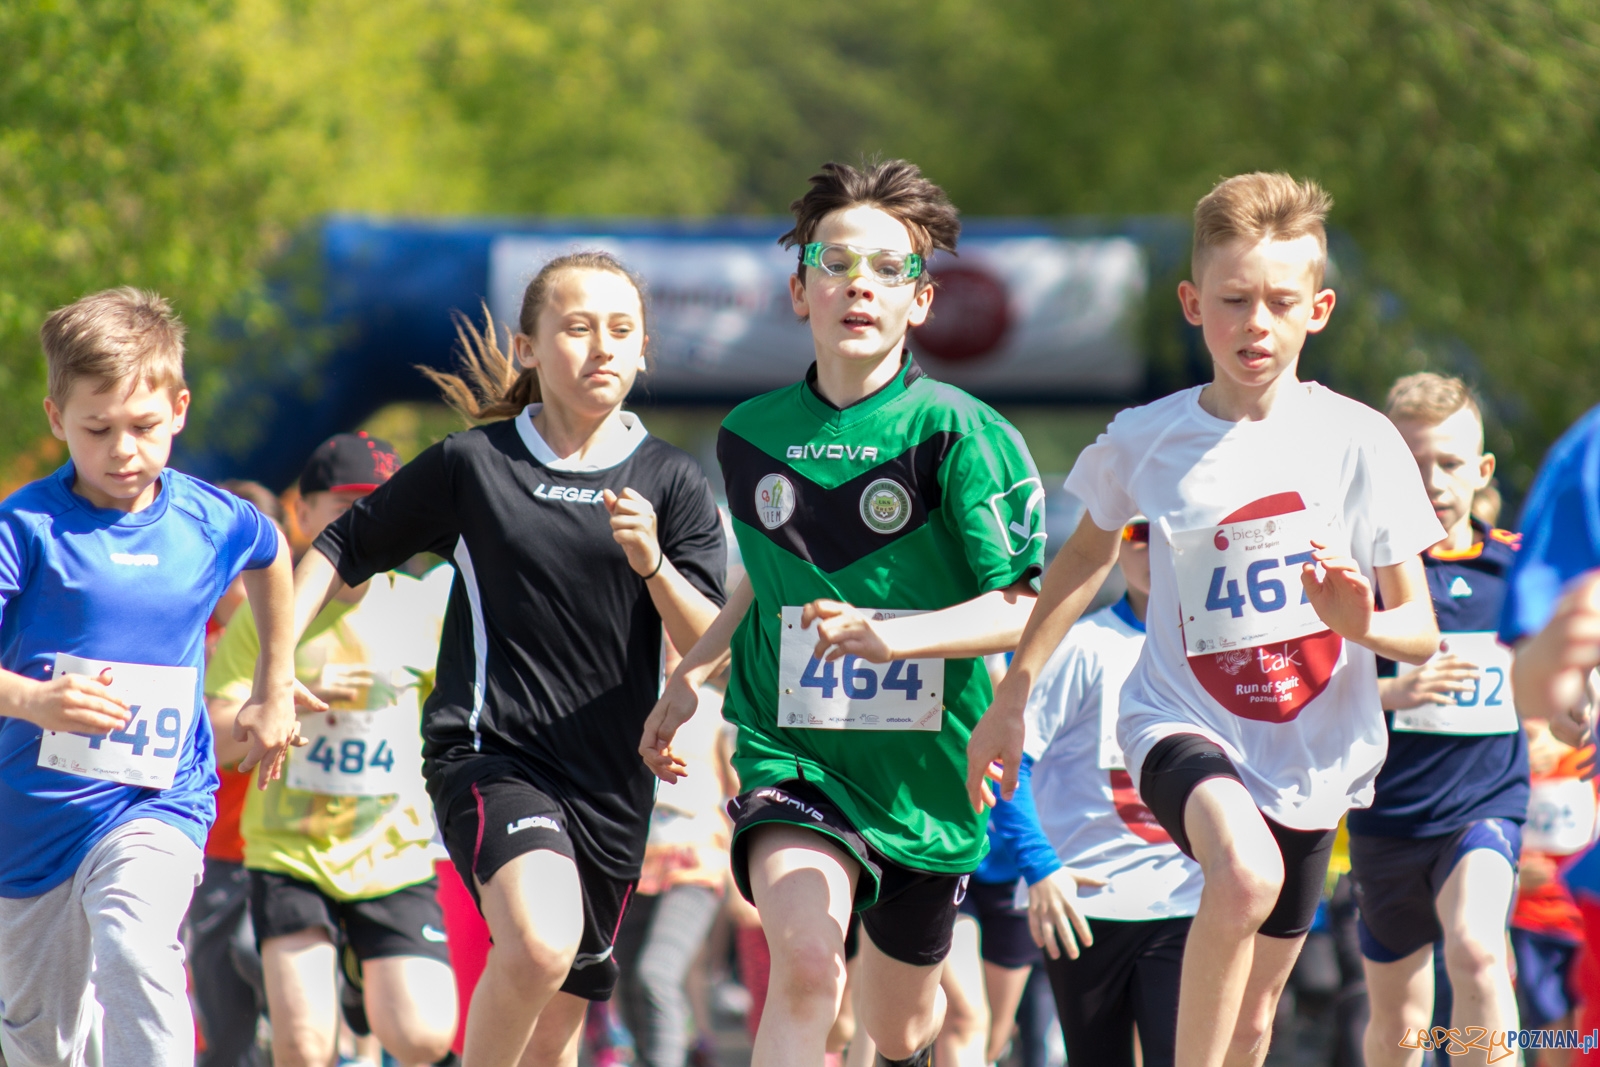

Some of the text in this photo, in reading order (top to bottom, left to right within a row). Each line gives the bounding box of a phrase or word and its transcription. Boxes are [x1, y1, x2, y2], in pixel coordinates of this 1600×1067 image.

[786, 445, 878, 461] GIVOVA
[1232, 526, 1265, 544] bieg
[1205, 549, 1318, 618] 467
[1257, 643, 1302, 673] tak
[799, 652, 923, 701] 464
[1236, 676, 1299, 695] Run of Spirit
[307, 735, 394, 774] 484
